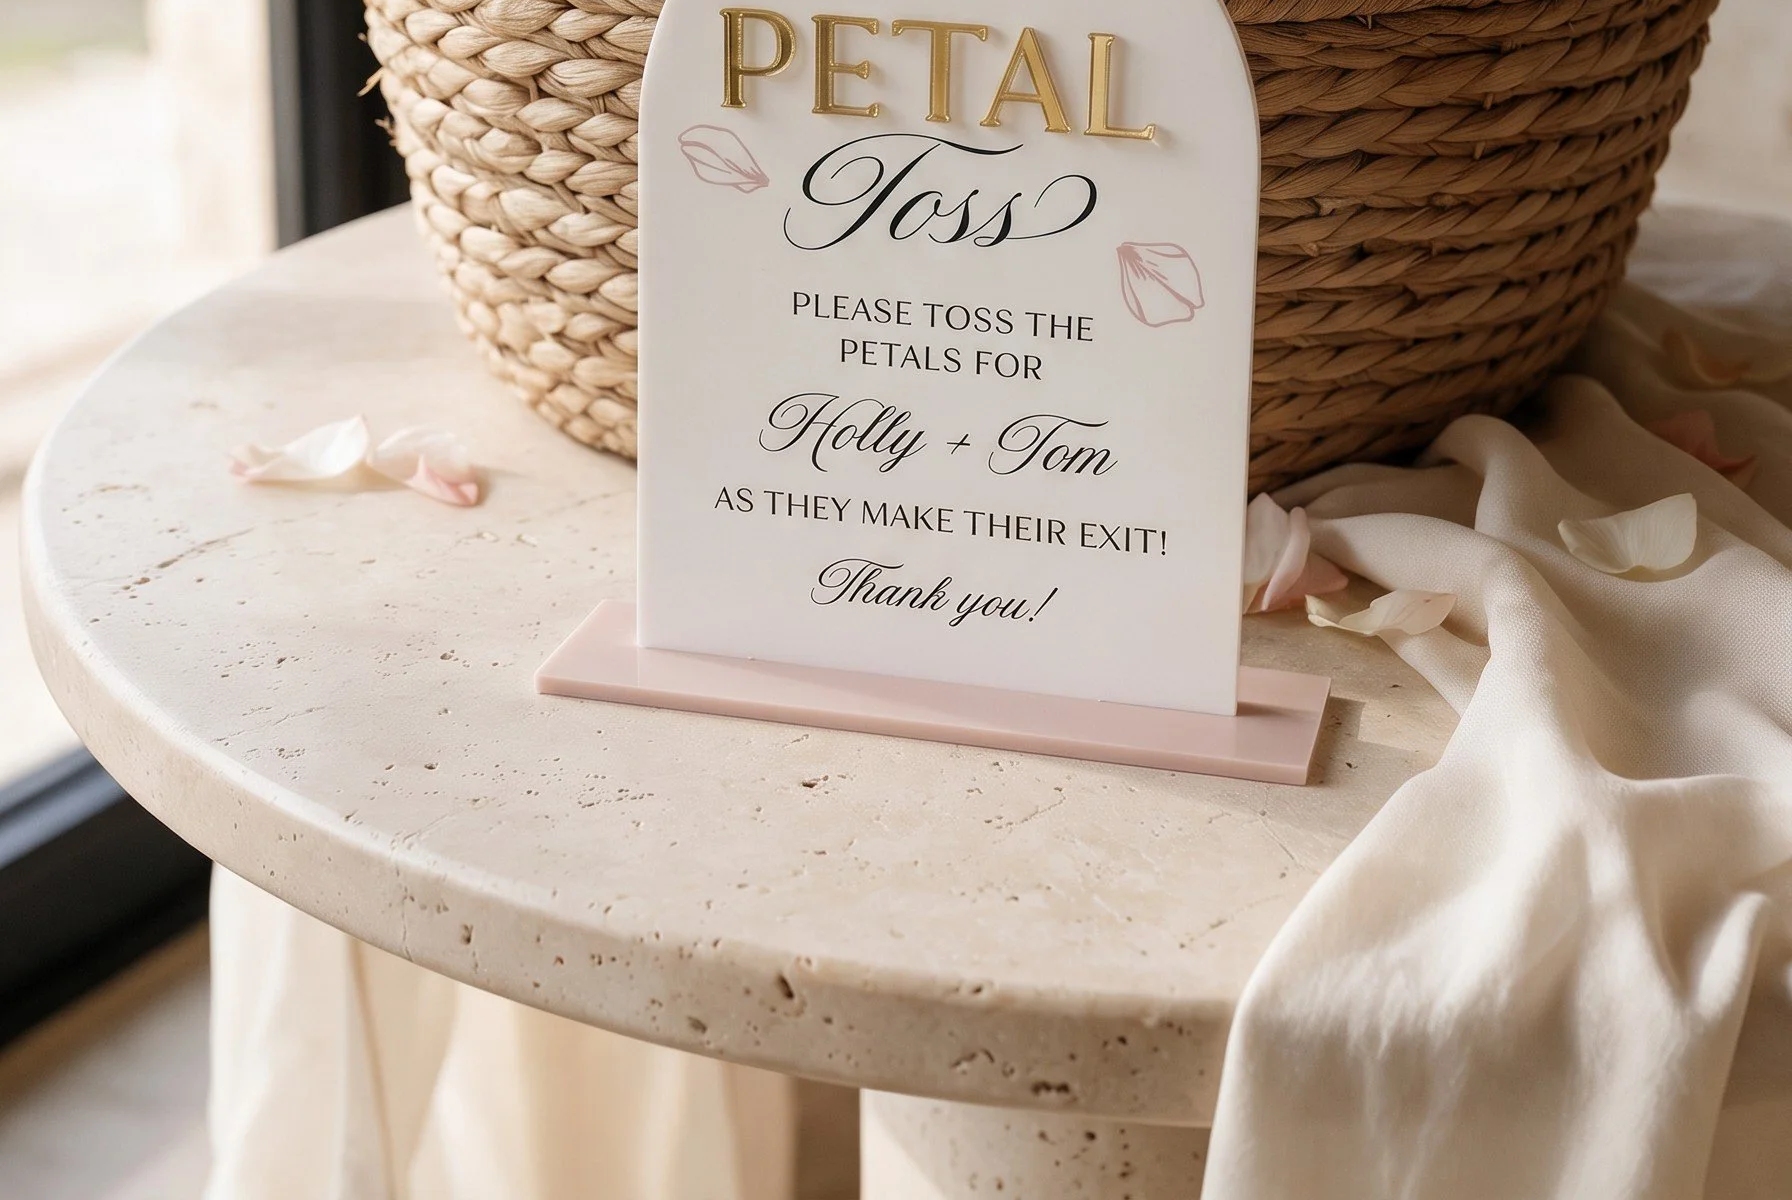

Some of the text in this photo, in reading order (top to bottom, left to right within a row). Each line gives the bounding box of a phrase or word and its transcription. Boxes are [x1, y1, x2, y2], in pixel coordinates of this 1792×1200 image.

[719, 7, 1157, 141] PETAL
[783, 133, 1098, 251] Toss
[792, 291, 1094, 342] PLEASE TOSS THE
[840, 338, 1042, 381] PETALS FOR
[758, 392, 1119, 476] Holly + Tom
[714, 486, 1168, 556] AS THEY MAKE THEIR EXIT!
[810, 558, 1059, 628] Thank you!
